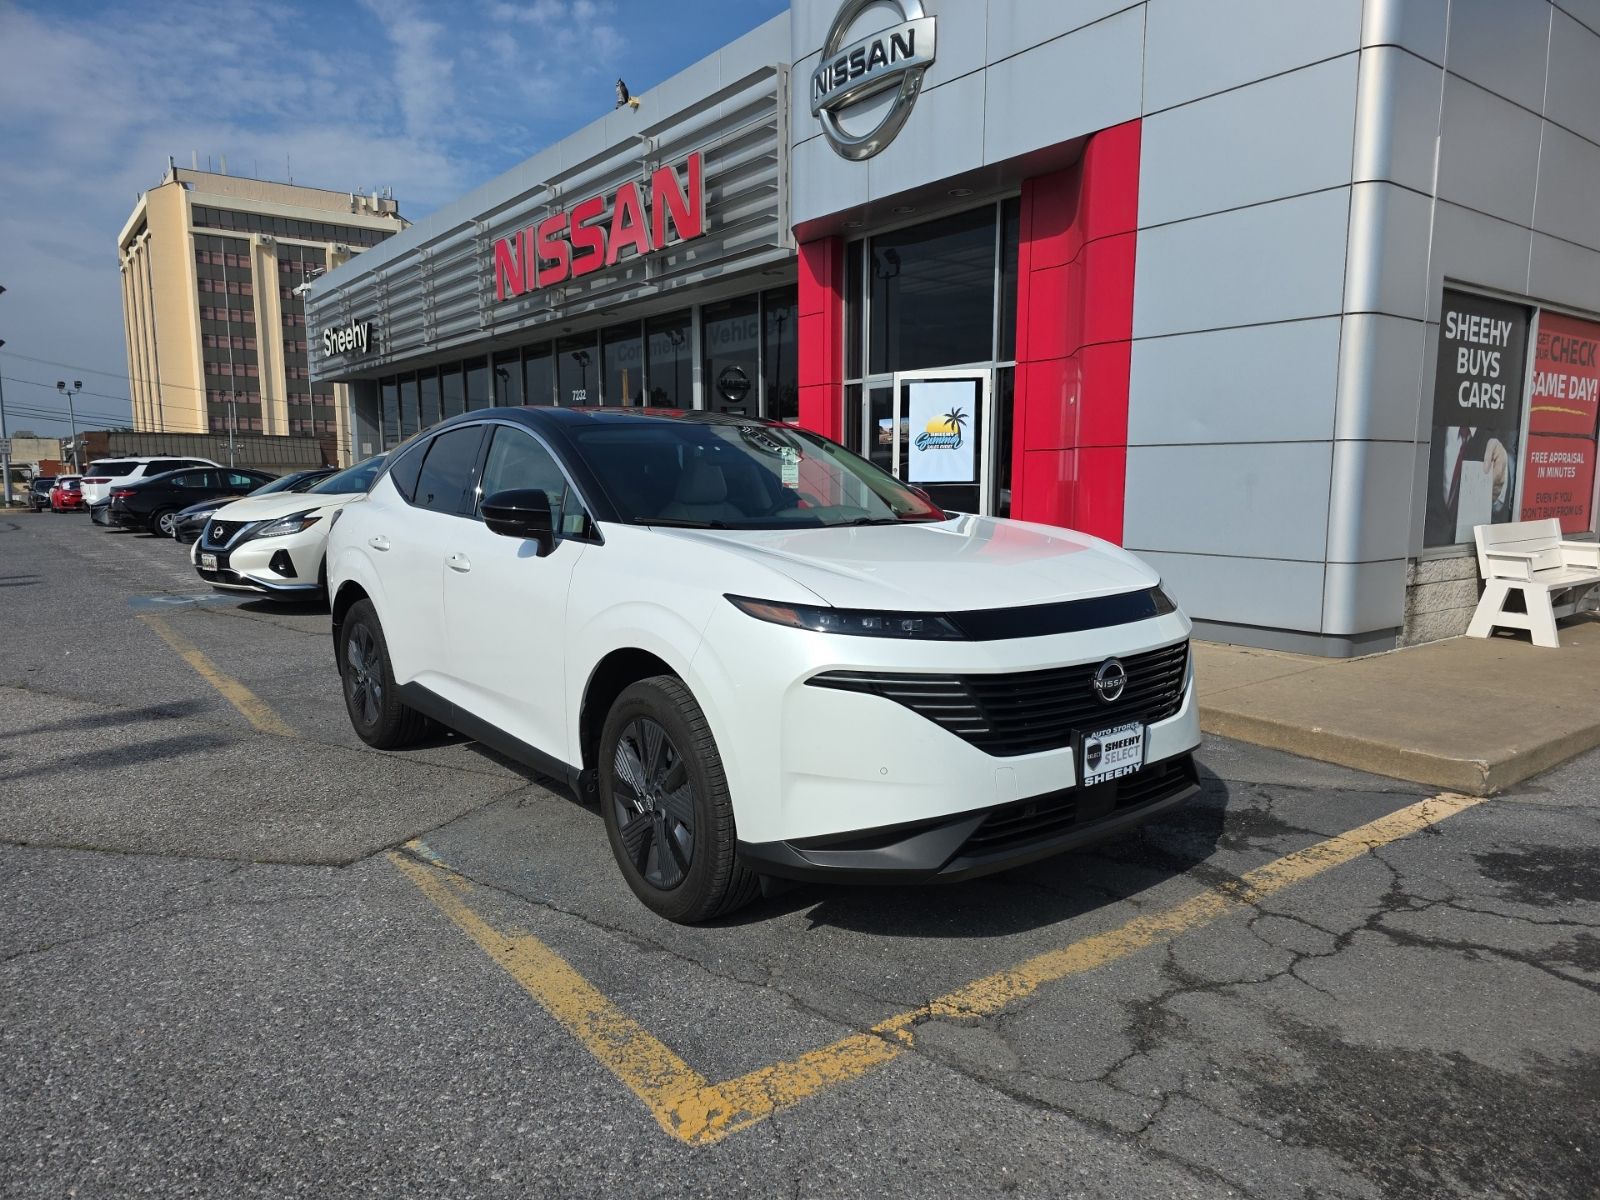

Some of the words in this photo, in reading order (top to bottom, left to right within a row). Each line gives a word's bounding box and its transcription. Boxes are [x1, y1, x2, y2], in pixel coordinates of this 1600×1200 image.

[815, 28, 915, 101] NISSAN
[495, 151, 703, 301] NISSAN
[323, 318, 368, 357] Sheehy
[1445, 311, 1513, 347] SHEEHY
[1457, 347, 1501, 378] BUYS
[1551, 336, 1598, 368] CHECK
[572, 389, 587, 401] 7232
[1459, 381, 1506, 409] CARS!
[1568, 375, 1598, 402] DAY!
[1531, 452, 1549, 463] FREE
[1549, 452, 1585, 464] APPRAISAL
[1538, 467, 1545, 478] IN
[1546, 467, 1576, 478] MINUTES
[1535, 491, 1552, 504] EVEN
[1559, 491, 1573, 503] YOU
[1095, 675, 1127, 689] NISSAN
[1091, 728, 1112, 739] AUTO
[1105, 735, 1142, 753] SHEEHY
[1105, 745, 1140, 765] SELECT
[1085, 762, 1142, 787] SHEEHY
